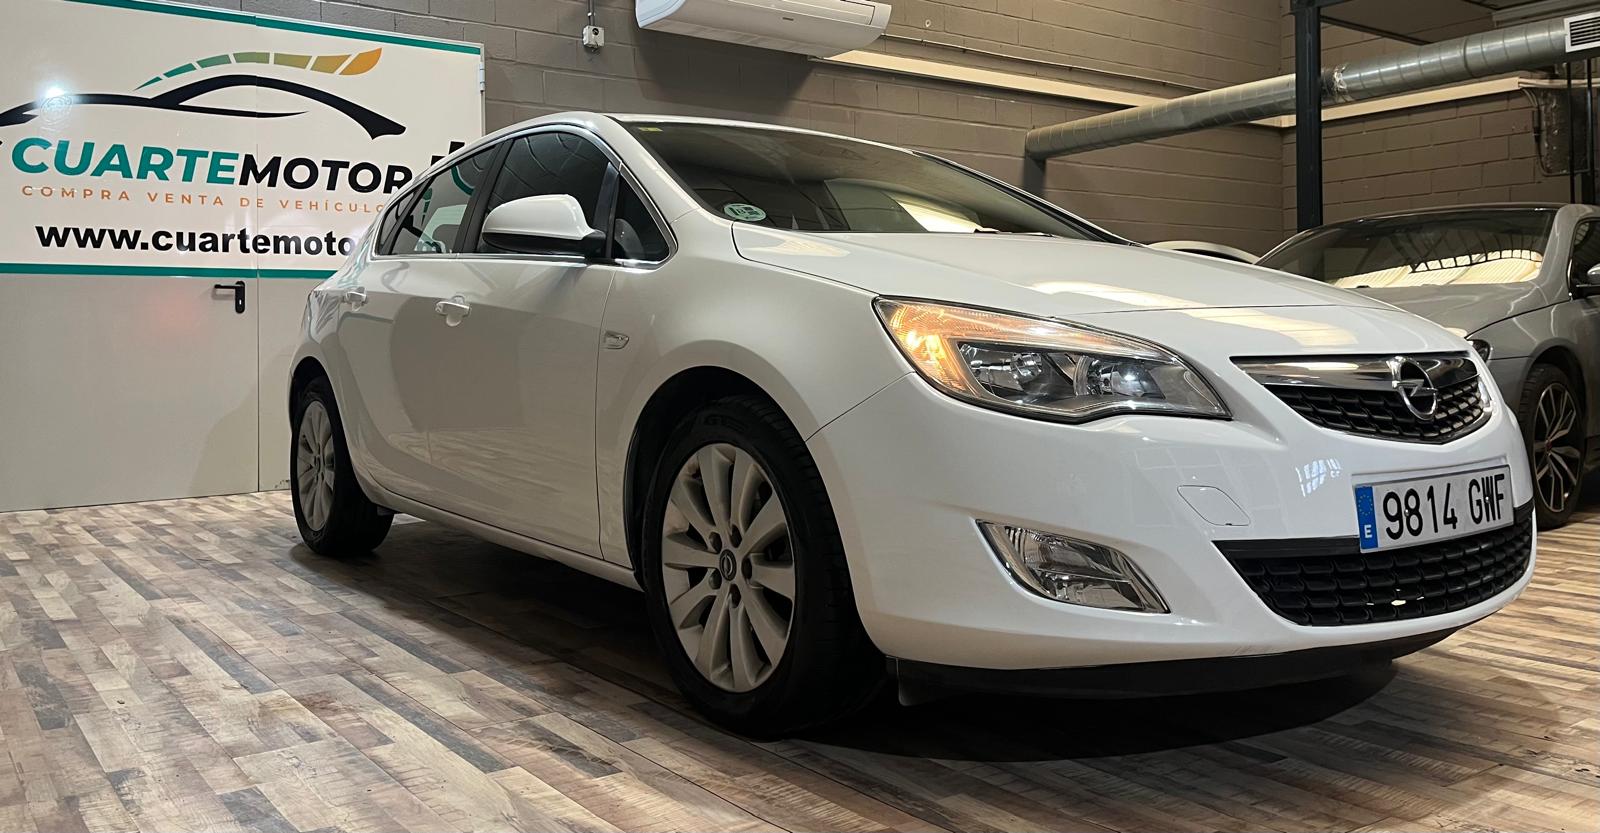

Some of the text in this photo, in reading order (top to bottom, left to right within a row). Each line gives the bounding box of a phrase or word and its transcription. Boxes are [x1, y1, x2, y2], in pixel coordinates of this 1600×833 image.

[11, 137, 413, 194] CUARTEMOTOR
[22, 185, 130, 201] COMPRA
[147, 192, 224, 206] VENTA
[240, 197, 264, 208] DE
[35, 225, 356, 256] www.cuartemoto
[1382, 473, 1505, 540] 9814 GWF
[1364, 524, 1373, 539] E
